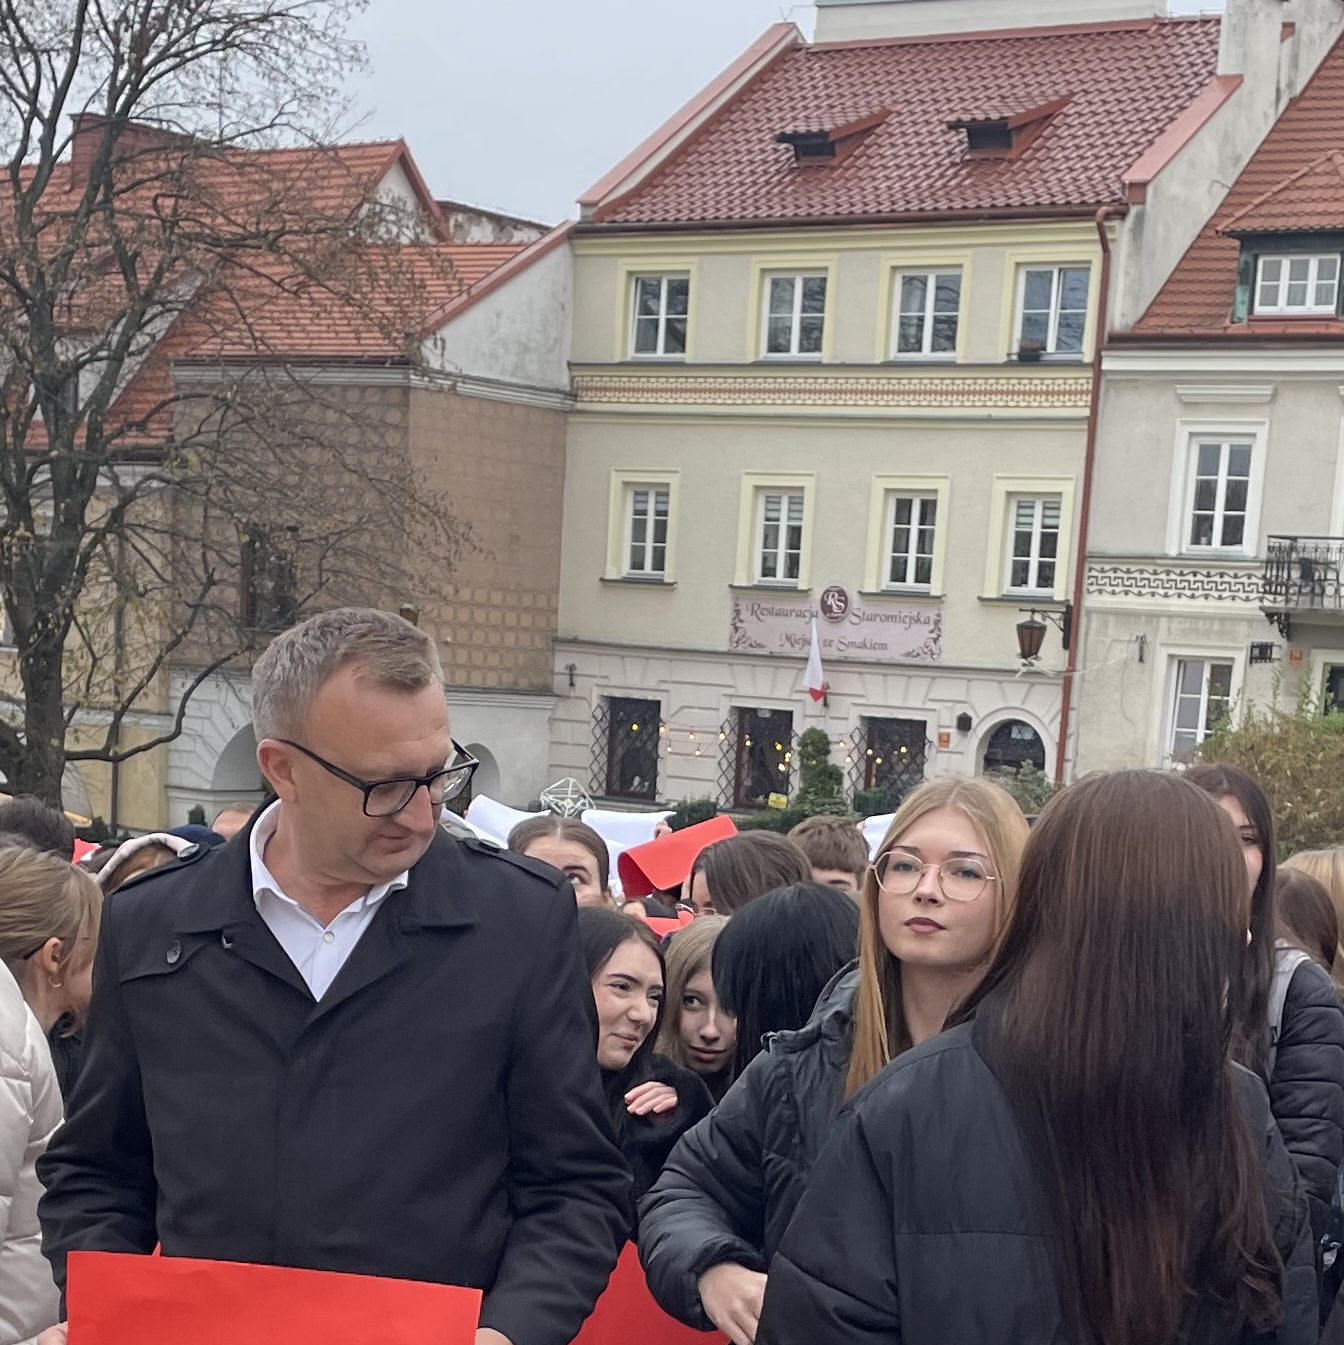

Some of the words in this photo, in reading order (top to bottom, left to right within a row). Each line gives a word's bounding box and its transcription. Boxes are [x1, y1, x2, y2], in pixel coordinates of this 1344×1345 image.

[747, 602, 819, 625] Restauracja
[848, 607, 931, 630] Staromiejska
[836, 636, 888, 652] Smakiem
